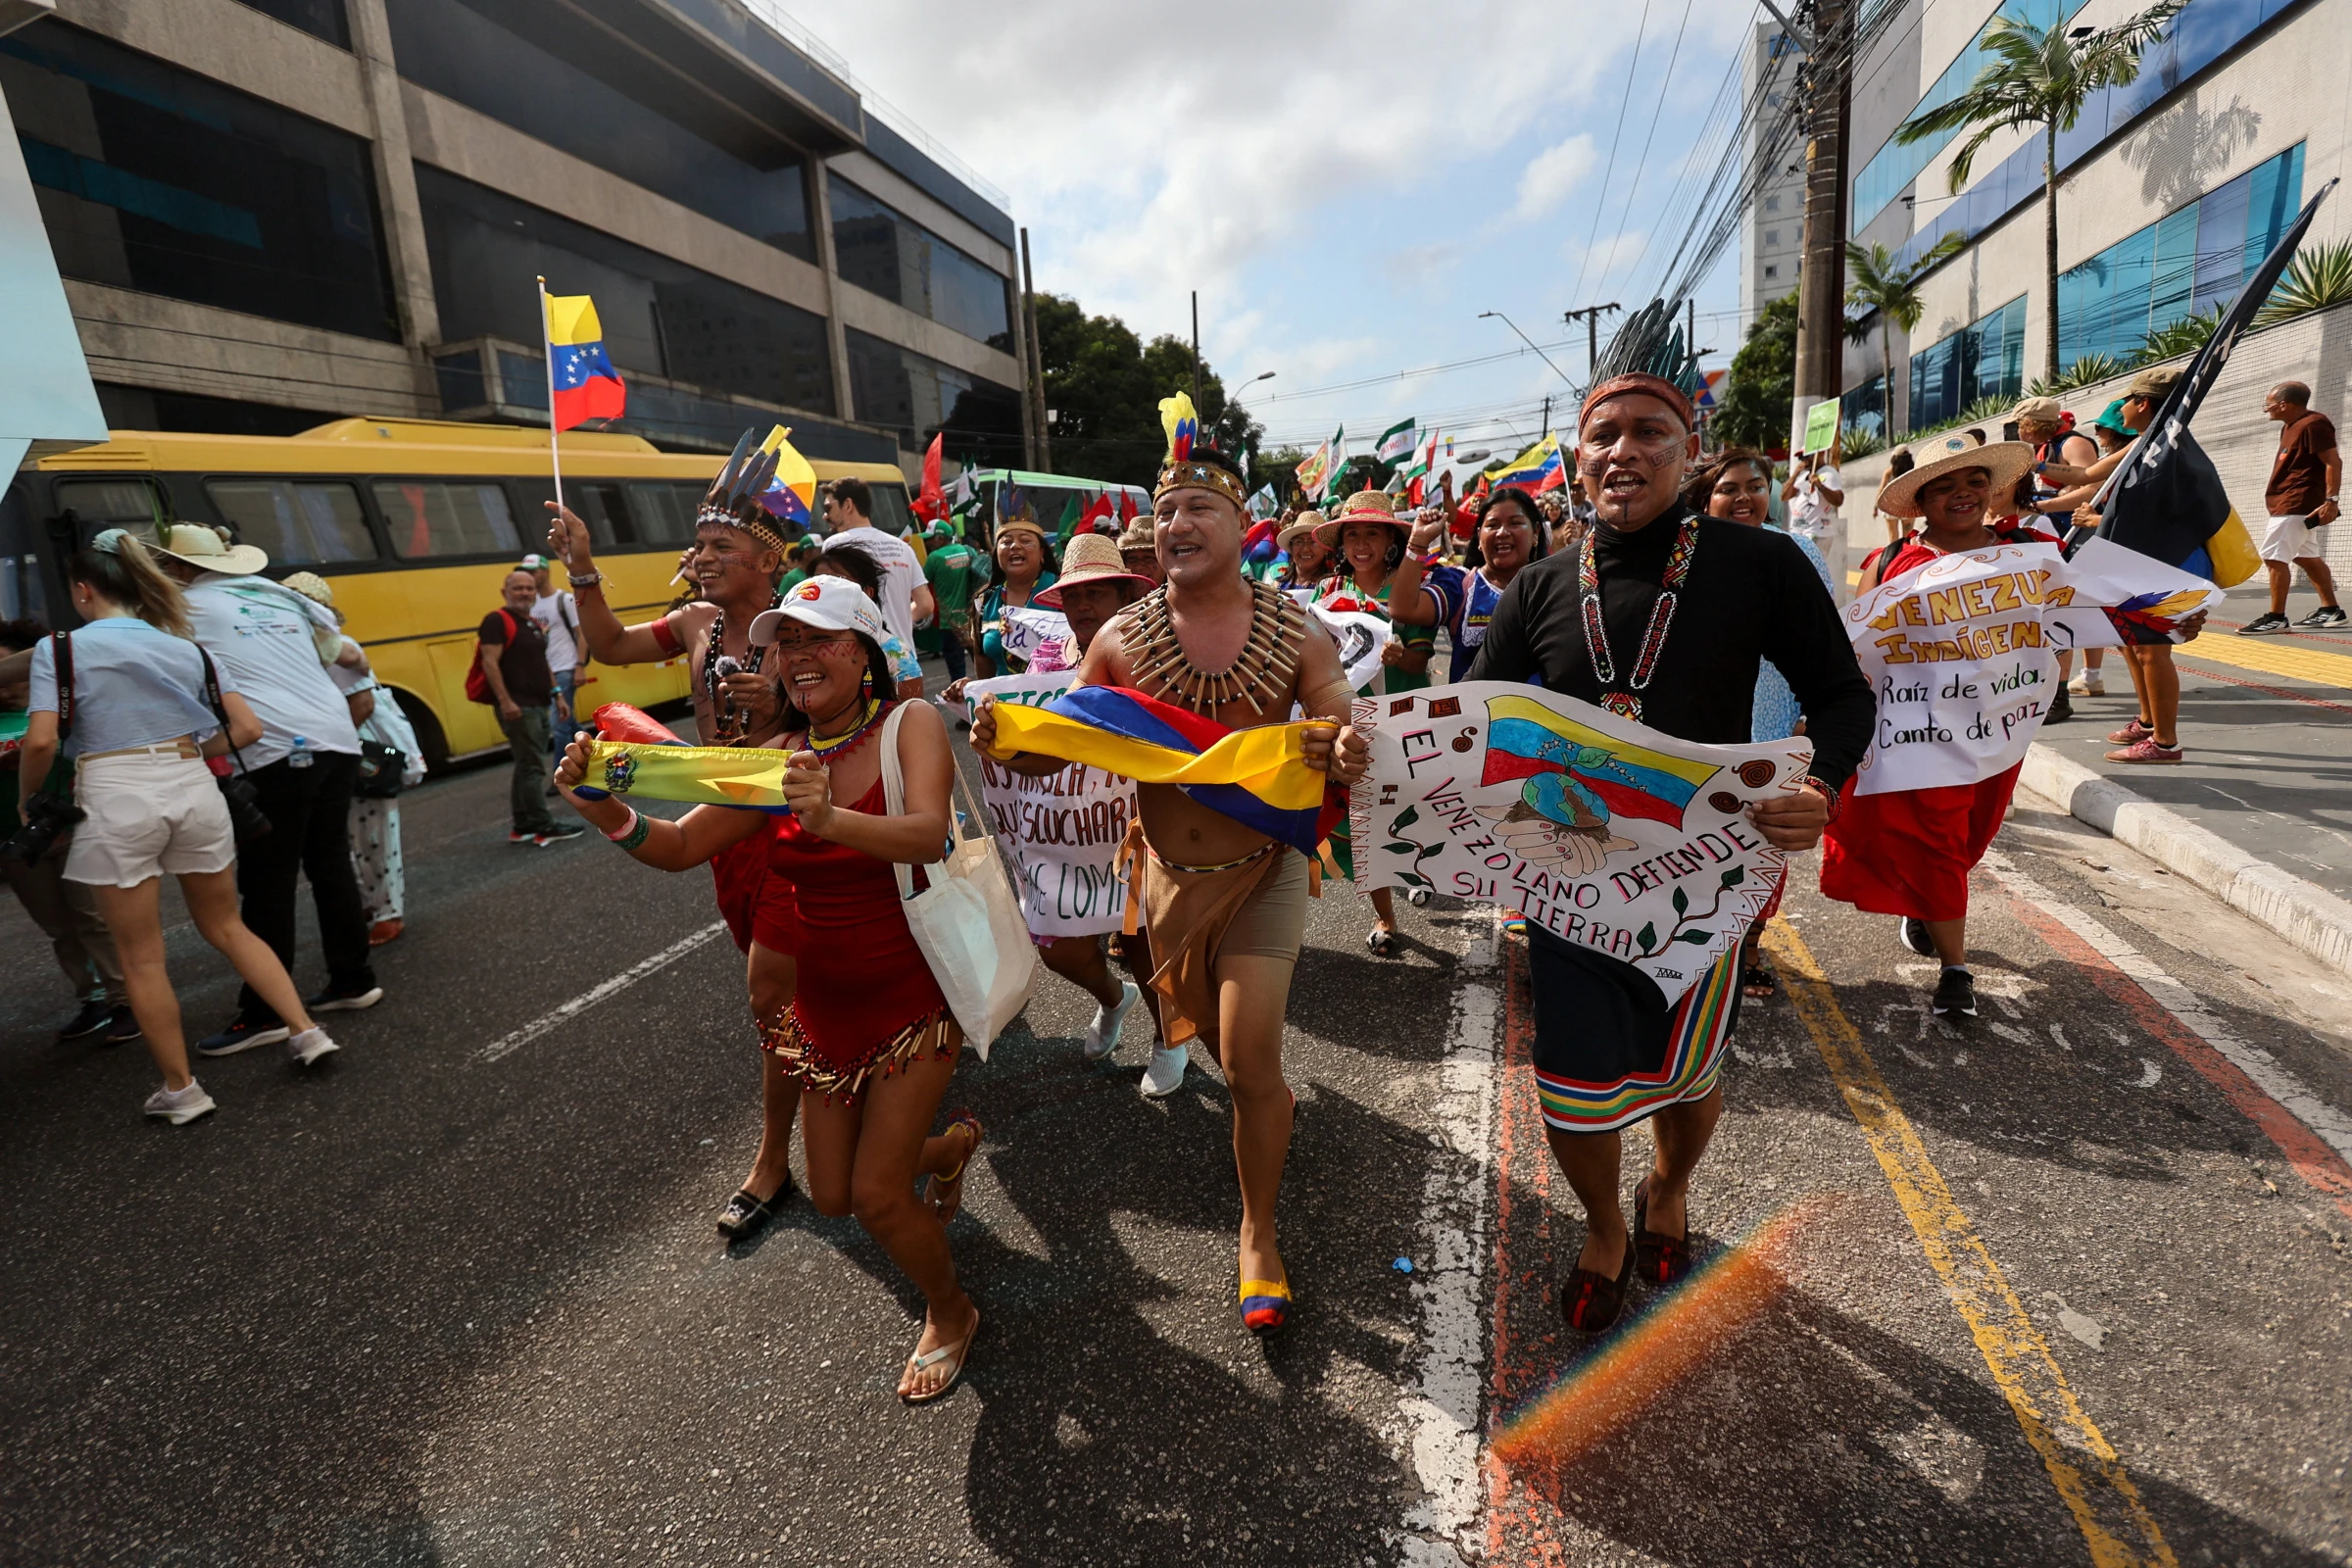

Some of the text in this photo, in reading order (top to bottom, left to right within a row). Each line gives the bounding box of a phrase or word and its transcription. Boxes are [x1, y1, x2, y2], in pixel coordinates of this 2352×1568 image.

[1874, 619, 2050, 664] INDÍGEN
[1881, 675, 1929, 706] Raíz
[1940, 673, 1980, 700] de
[1879, 701, 2046, 750] Canto de paz
[1402, 728, 1761, 910] EL VENEZOLANO DEFIENDE
[1451, 870, 1633, 958] SU TIERRA
